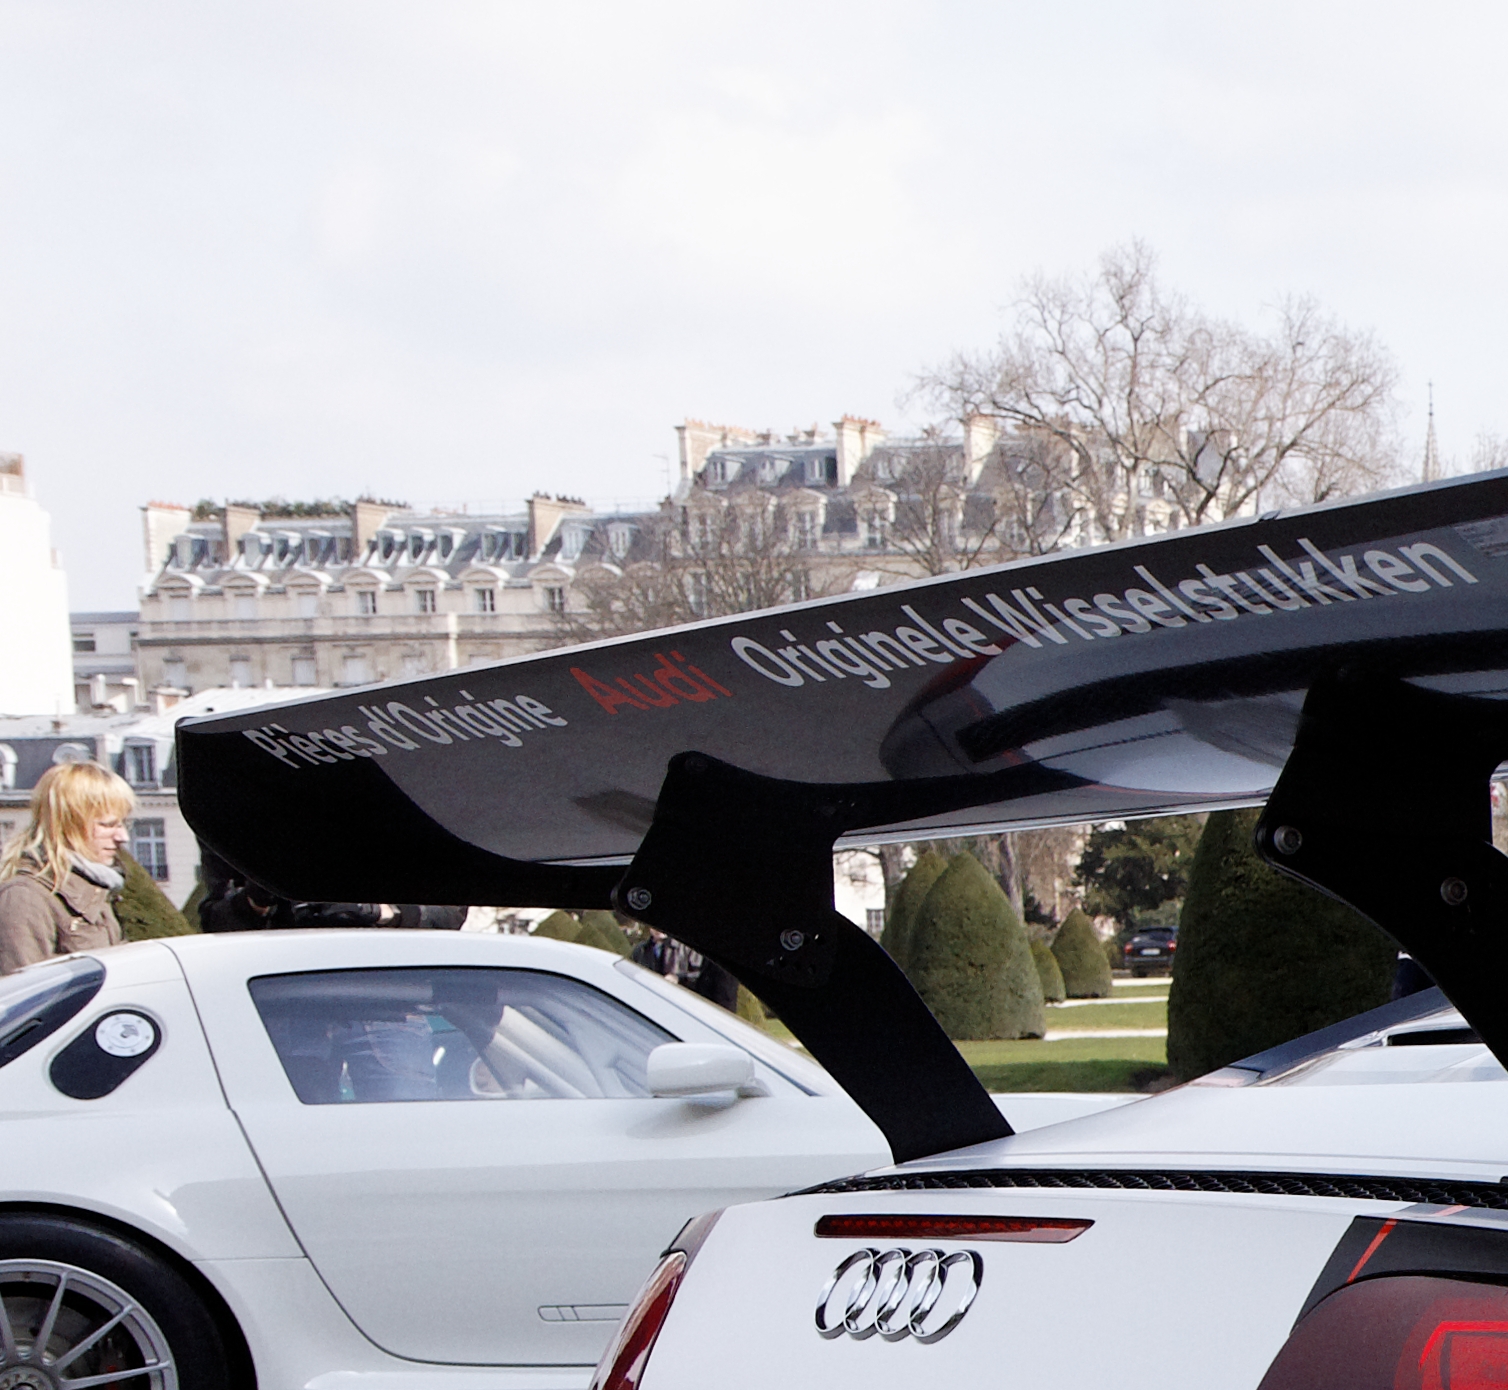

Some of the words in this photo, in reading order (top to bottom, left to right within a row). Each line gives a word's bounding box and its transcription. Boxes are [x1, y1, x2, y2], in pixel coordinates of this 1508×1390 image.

[358, 691, 568, 747] d'Origine
[570, 650, 732, 716] Audi
[730, 605, 1002, 689] Originele
[962, 538, 1479, 650] Wisselstukken
